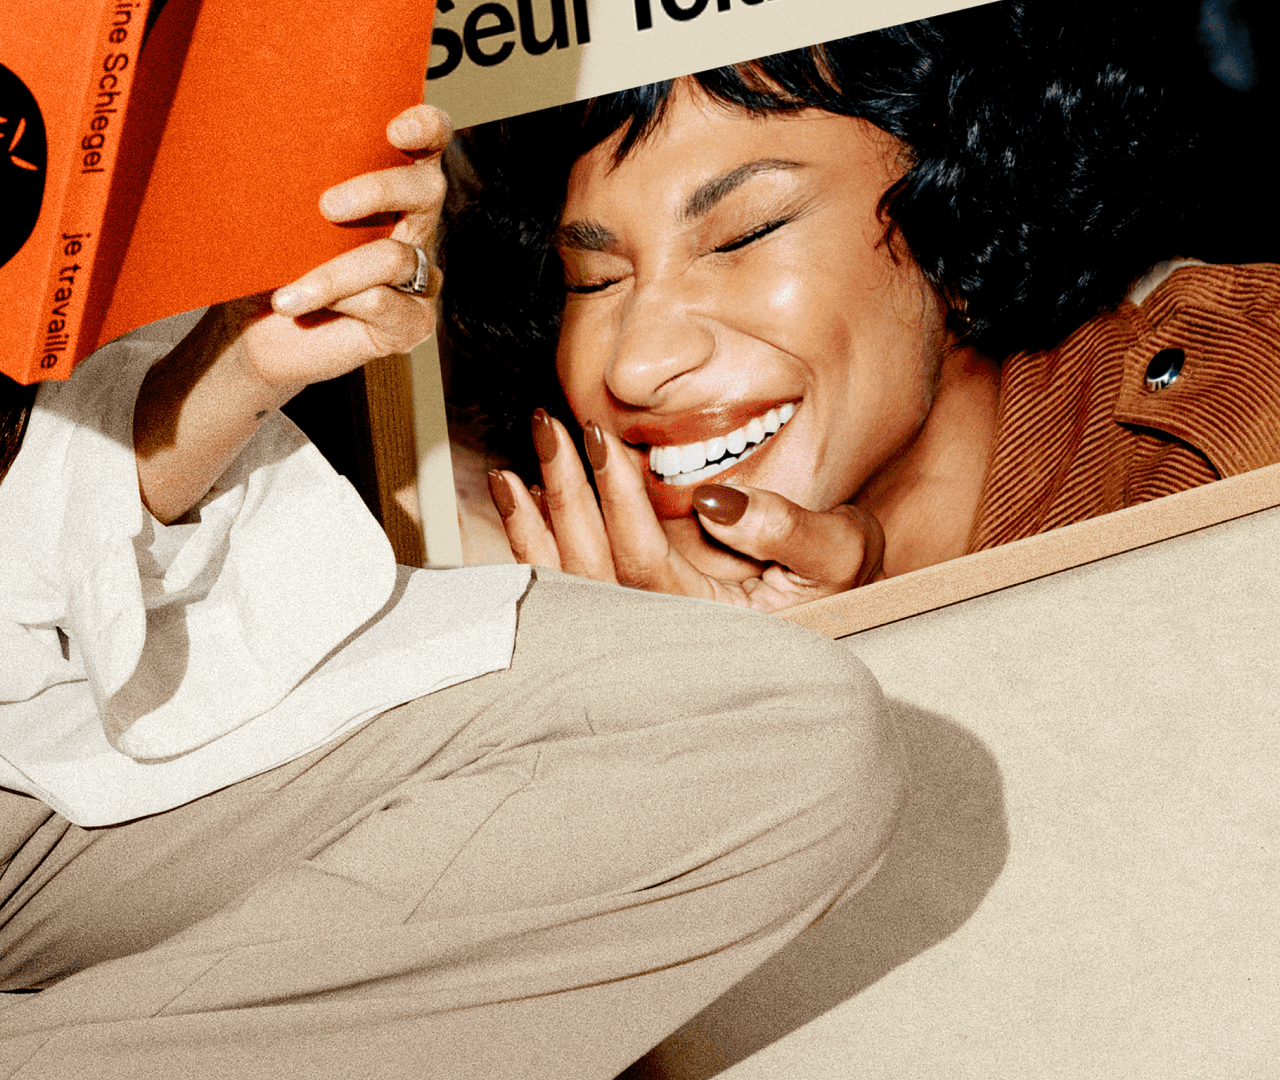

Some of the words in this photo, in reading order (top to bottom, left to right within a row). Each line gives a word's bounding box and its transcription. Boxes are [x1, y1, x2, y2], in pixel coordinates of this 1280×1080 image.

[80, 52, 130, 175] Schlegel
[63, 231, 90, 255] je
[41, 258, 81, 370] travaille
